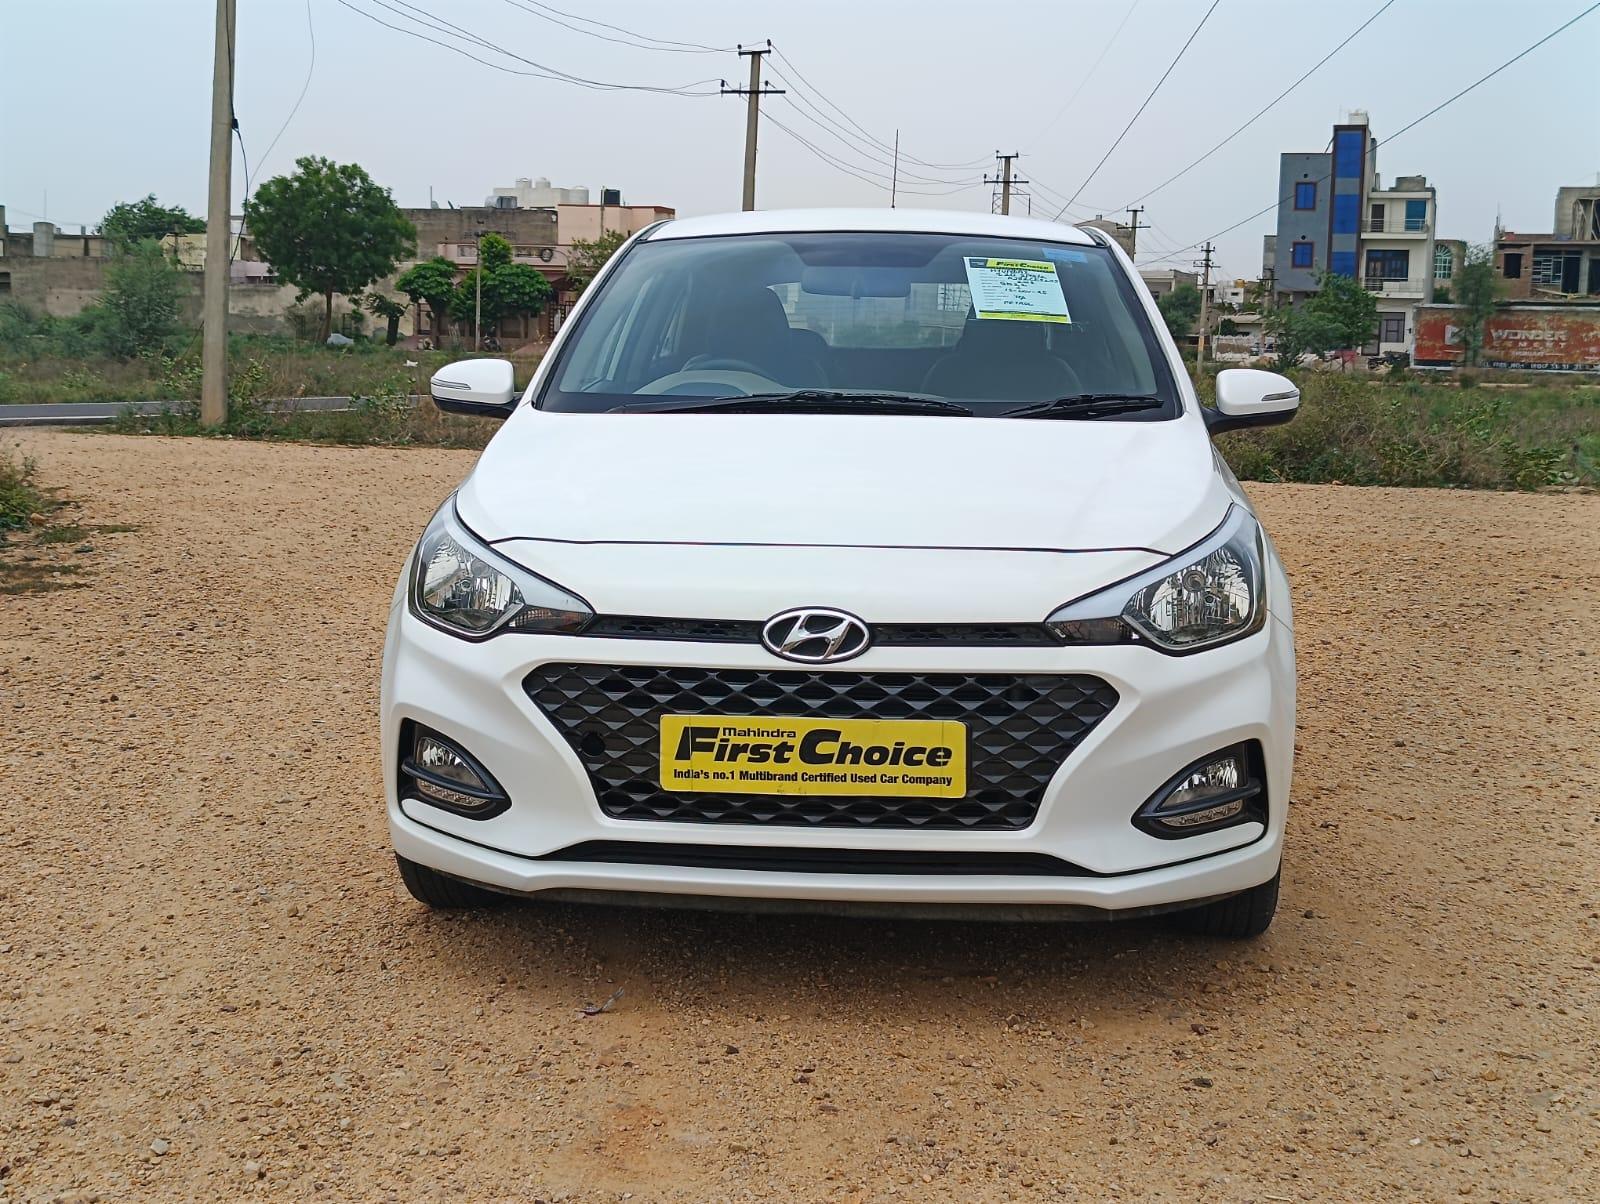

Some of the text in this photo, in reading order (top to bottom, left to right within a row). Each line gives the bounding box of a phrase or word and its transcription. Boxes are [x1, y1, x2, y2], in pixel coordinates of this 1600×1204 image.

[1490, 329, 1568, 341] WONDER
[722, 727, 796, 738] Mahindra
[674, 726, 953, 767] First Choice
[673, 769, 953, 787] India's no.1 Multibrand Certified Used Car Company
